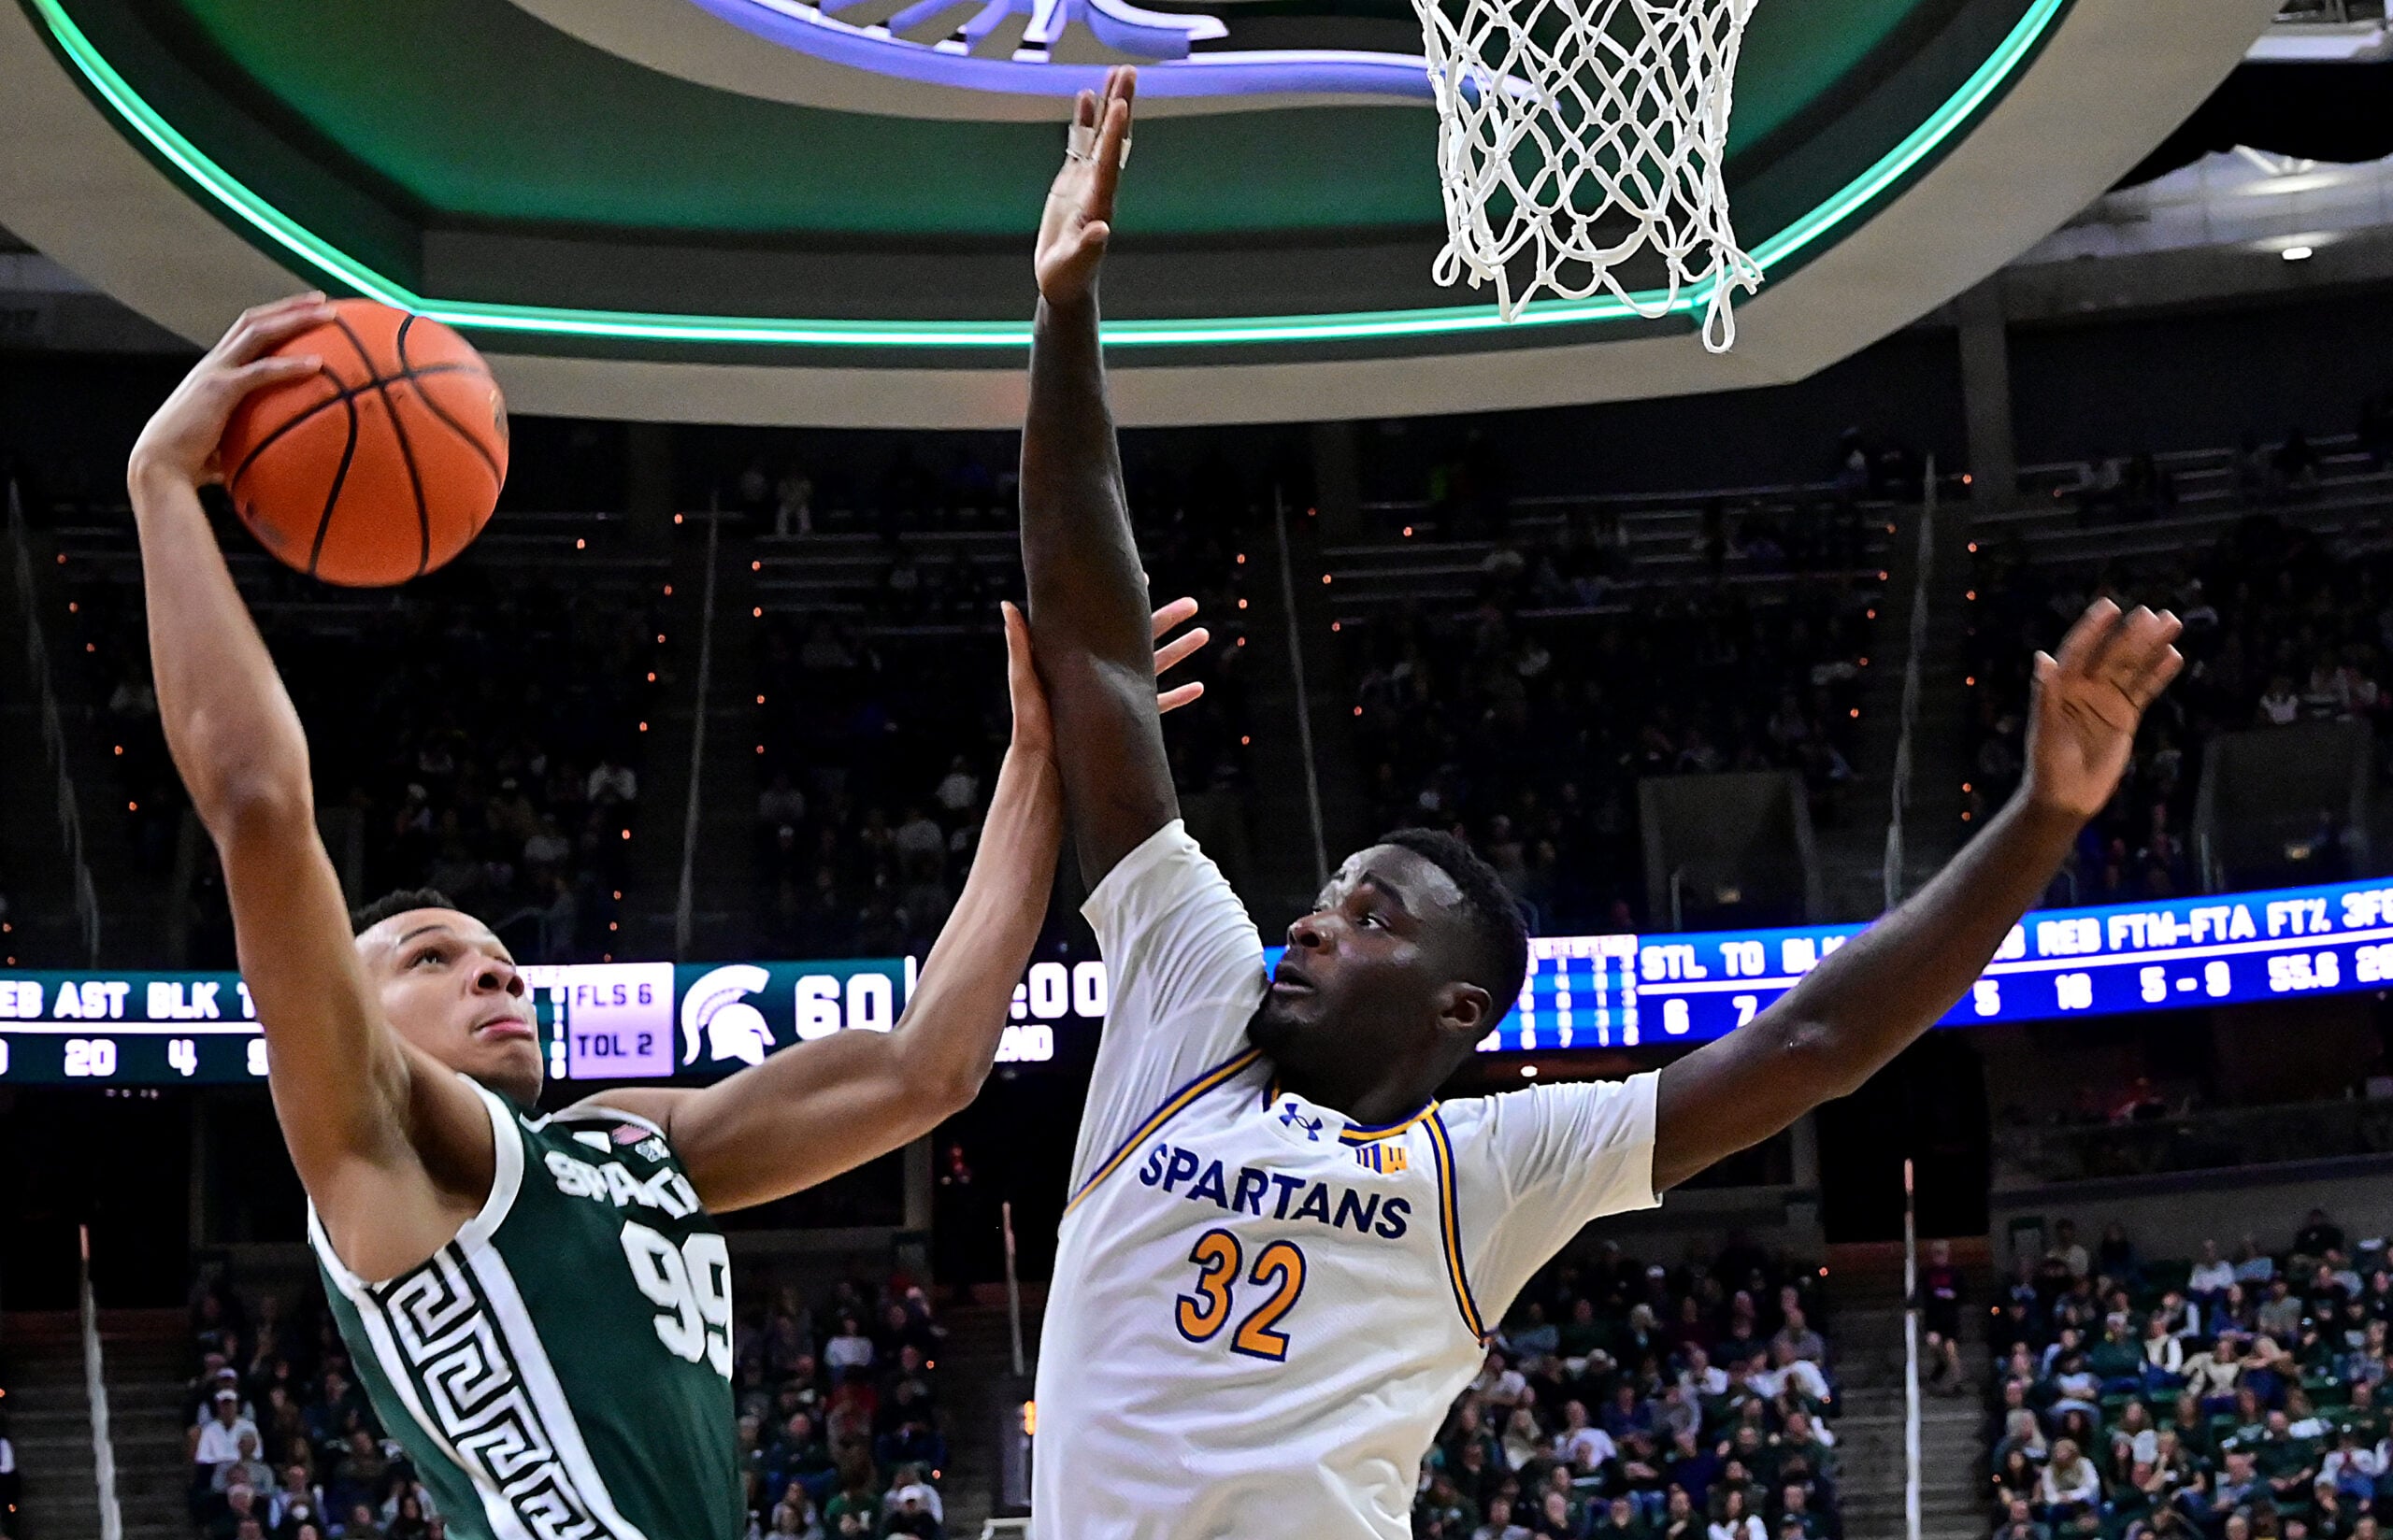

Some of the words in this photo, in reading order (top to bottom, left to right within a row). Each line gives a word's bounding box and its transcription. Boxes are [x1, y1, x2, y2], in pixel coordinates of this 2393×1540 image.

[1641, 945, 1707, 980] STL
[1720, 940, 1765, 977] TO
[53, 981, 130, 1019] AST
[148, 981, 220, 1019] BLK
[577, 983, 626, 1006] FLS
[638, 983, 652, 1005] 6
[795, 973, 893, 1041] 60
[64, 1039, 116, 1077] 20
[168, 1039, 197, 1077] 4
[577, 1034, 627, 1057] TOL
[638, 1033, 652, 1056] 2
[1139, 1143, 1411, 1239] SPARTANS
[620, 1219, 734, 1383] 99
[1175, 1228, 1308, 1362] 32
